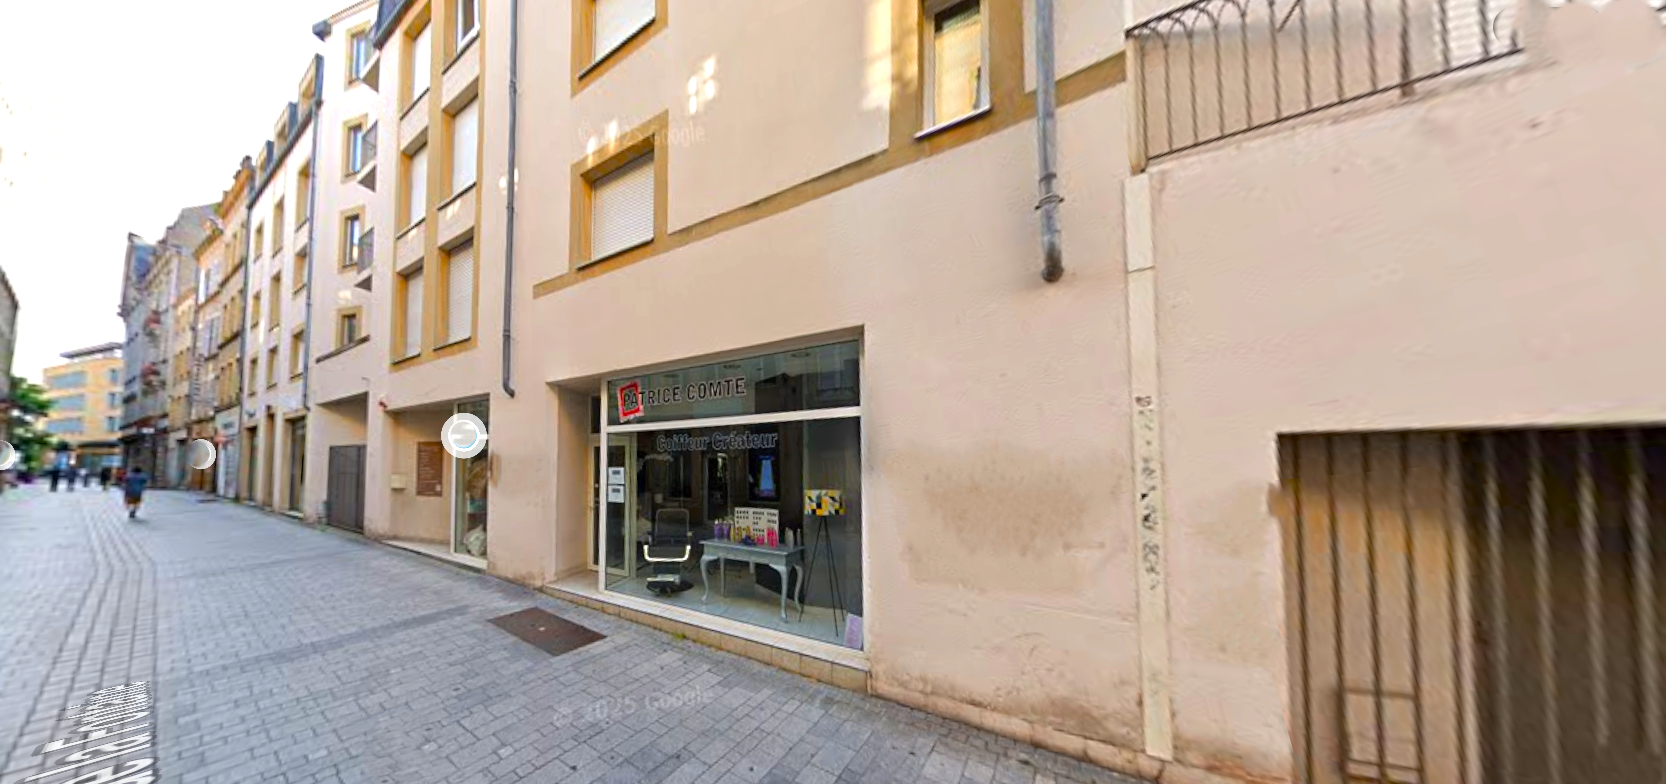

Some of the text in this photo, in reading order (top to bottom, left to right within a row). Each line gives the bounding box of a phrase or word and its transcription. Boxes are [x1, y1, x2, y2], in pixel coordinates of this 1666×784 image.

[622, 376, 746, 407] PATRICE COMTE
[656, 431, 778, 452] Coiffeur Créateur
